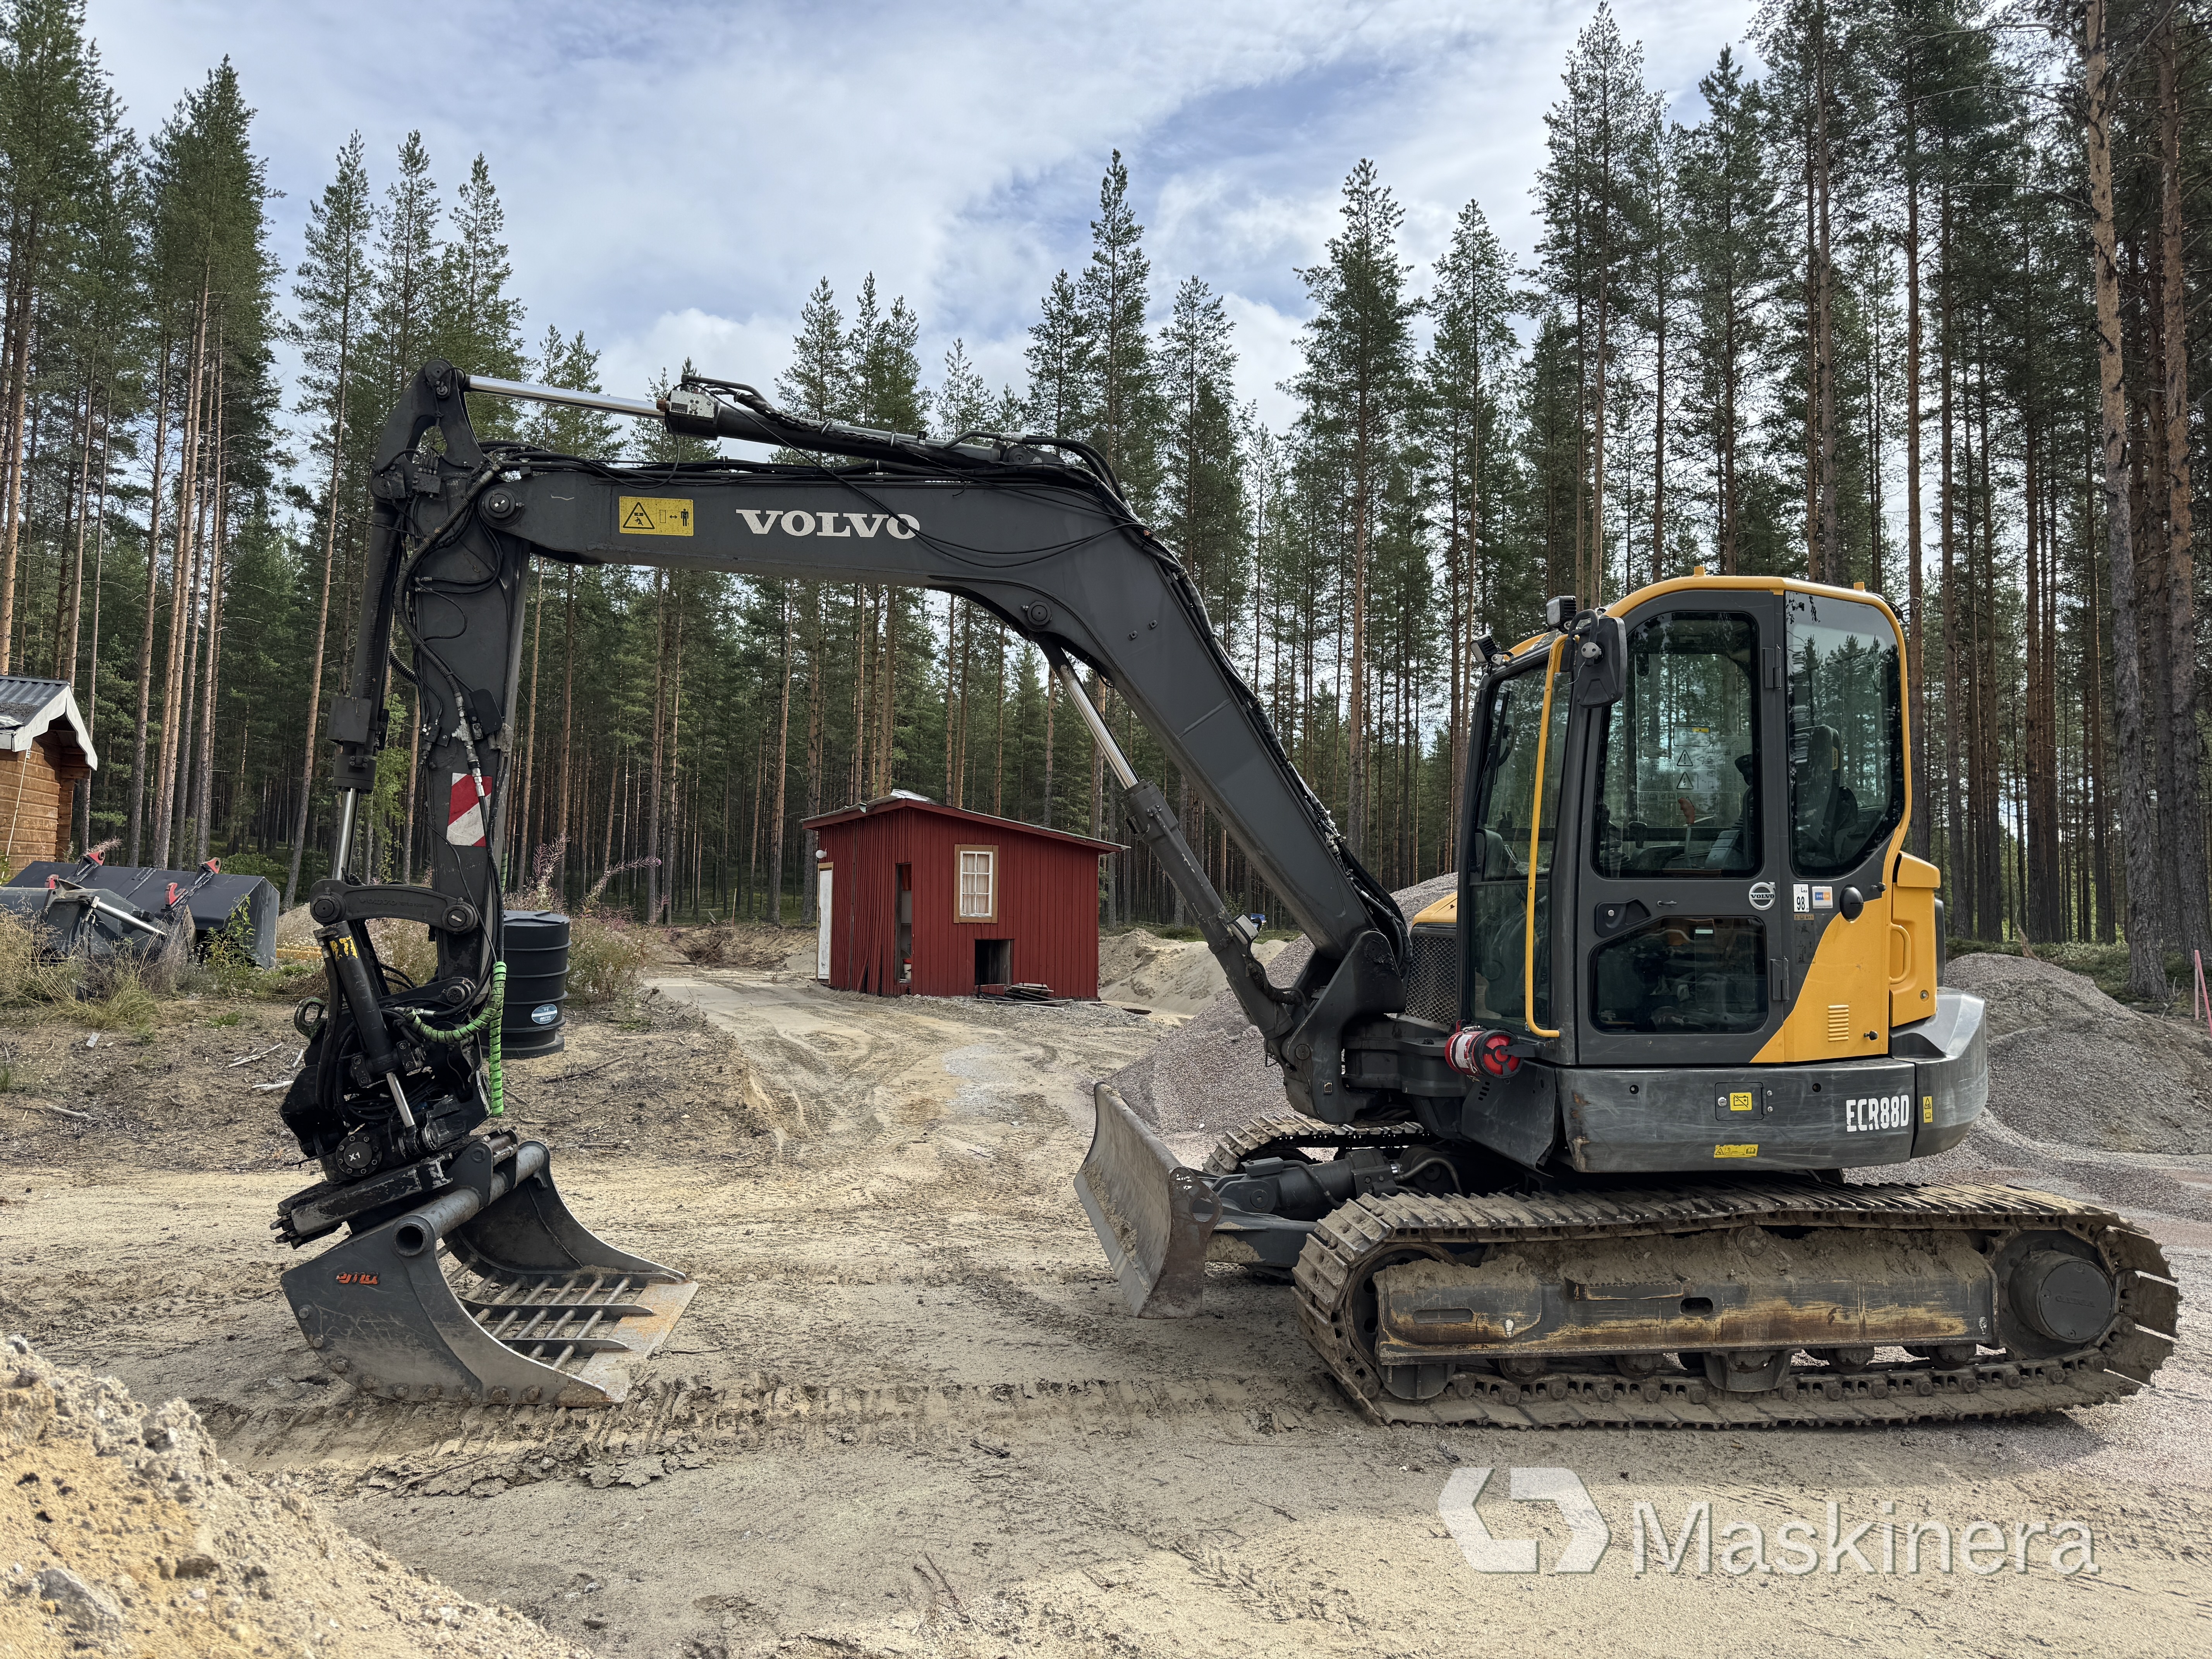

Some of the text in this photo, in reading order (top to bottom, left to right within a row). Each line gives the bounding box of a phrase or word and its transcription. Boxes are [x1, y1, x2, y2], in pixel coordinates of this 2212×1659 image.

[736, 509, 920, 539] VOLVO
[1797, 896, 1805, 910] 98
[1846, 1095, 1909, 1132] ECR88D
